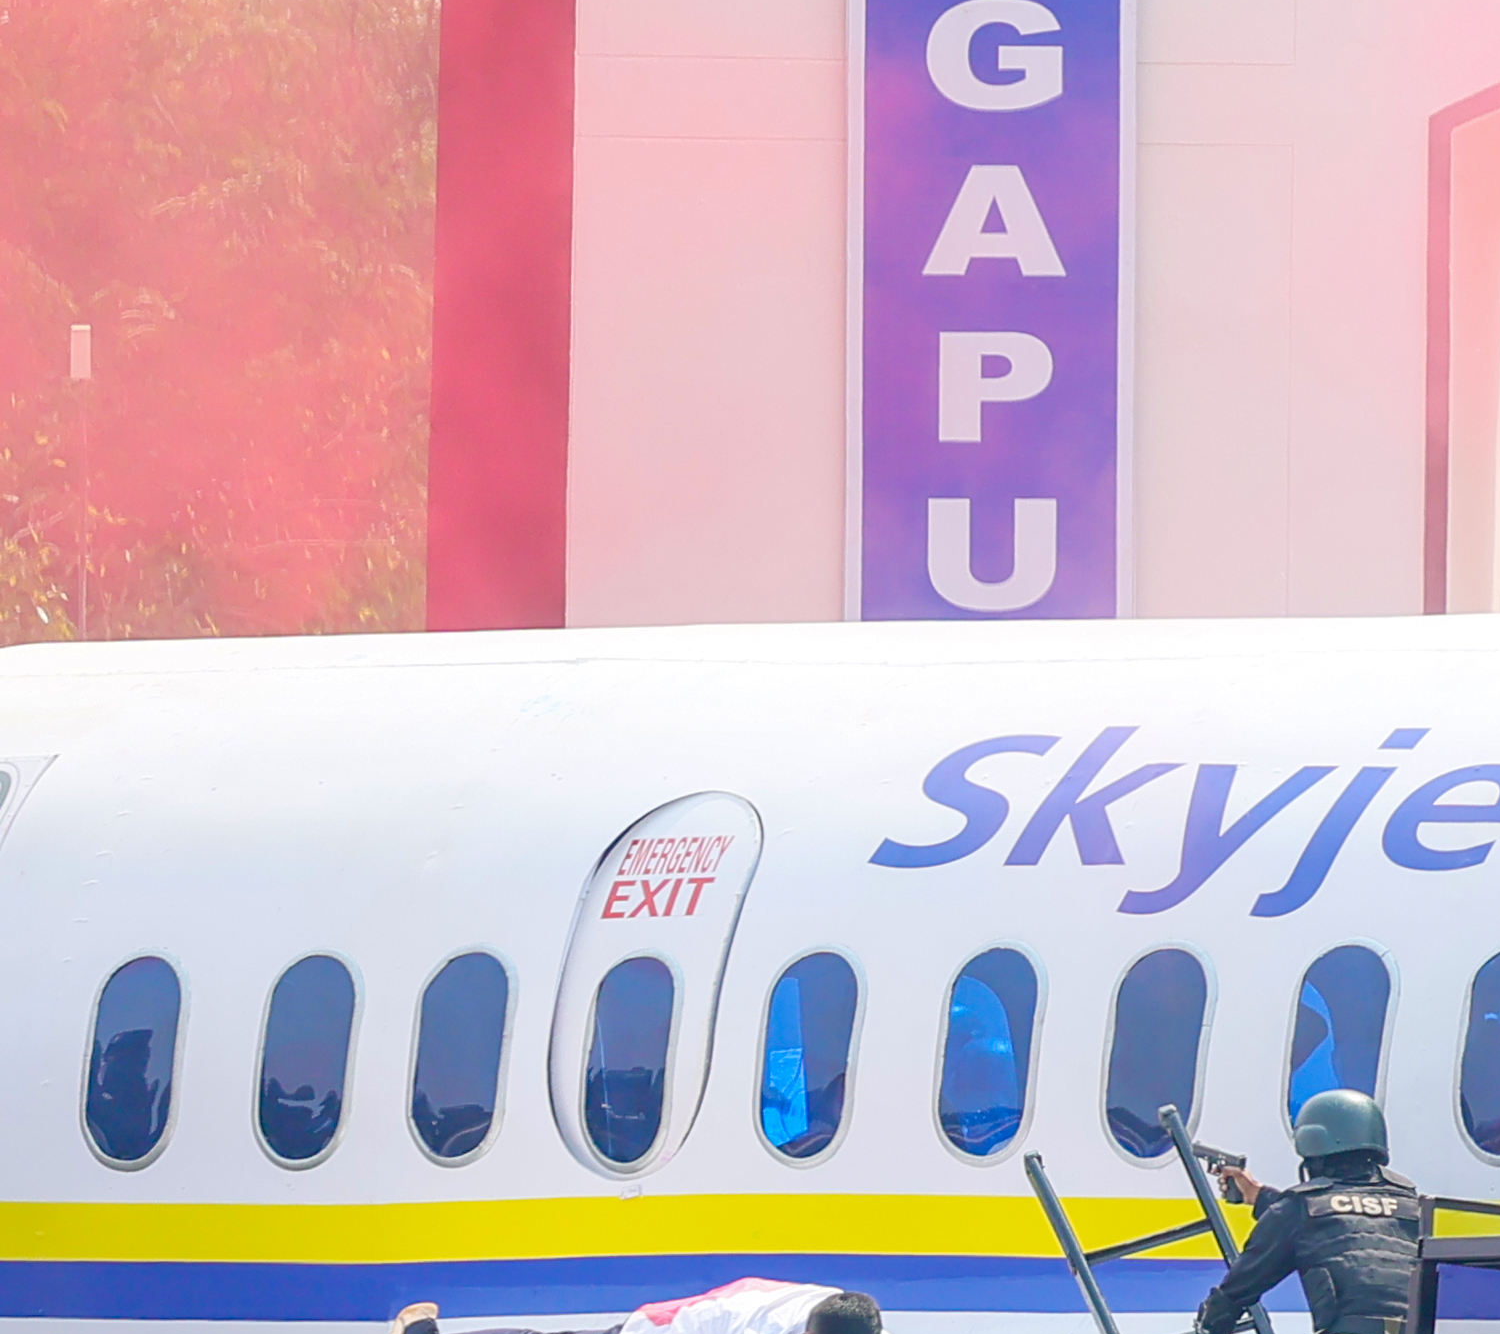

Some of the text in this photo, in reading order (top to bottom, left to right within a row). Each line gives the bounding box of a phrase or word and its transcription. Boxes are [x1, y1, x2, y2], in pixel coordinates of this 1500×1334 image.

[616, 835, 736, 876] EMERGENCY
[600, 876, 717, 919] EXIT
[1330, 1195, 1398, 1216] CISF
